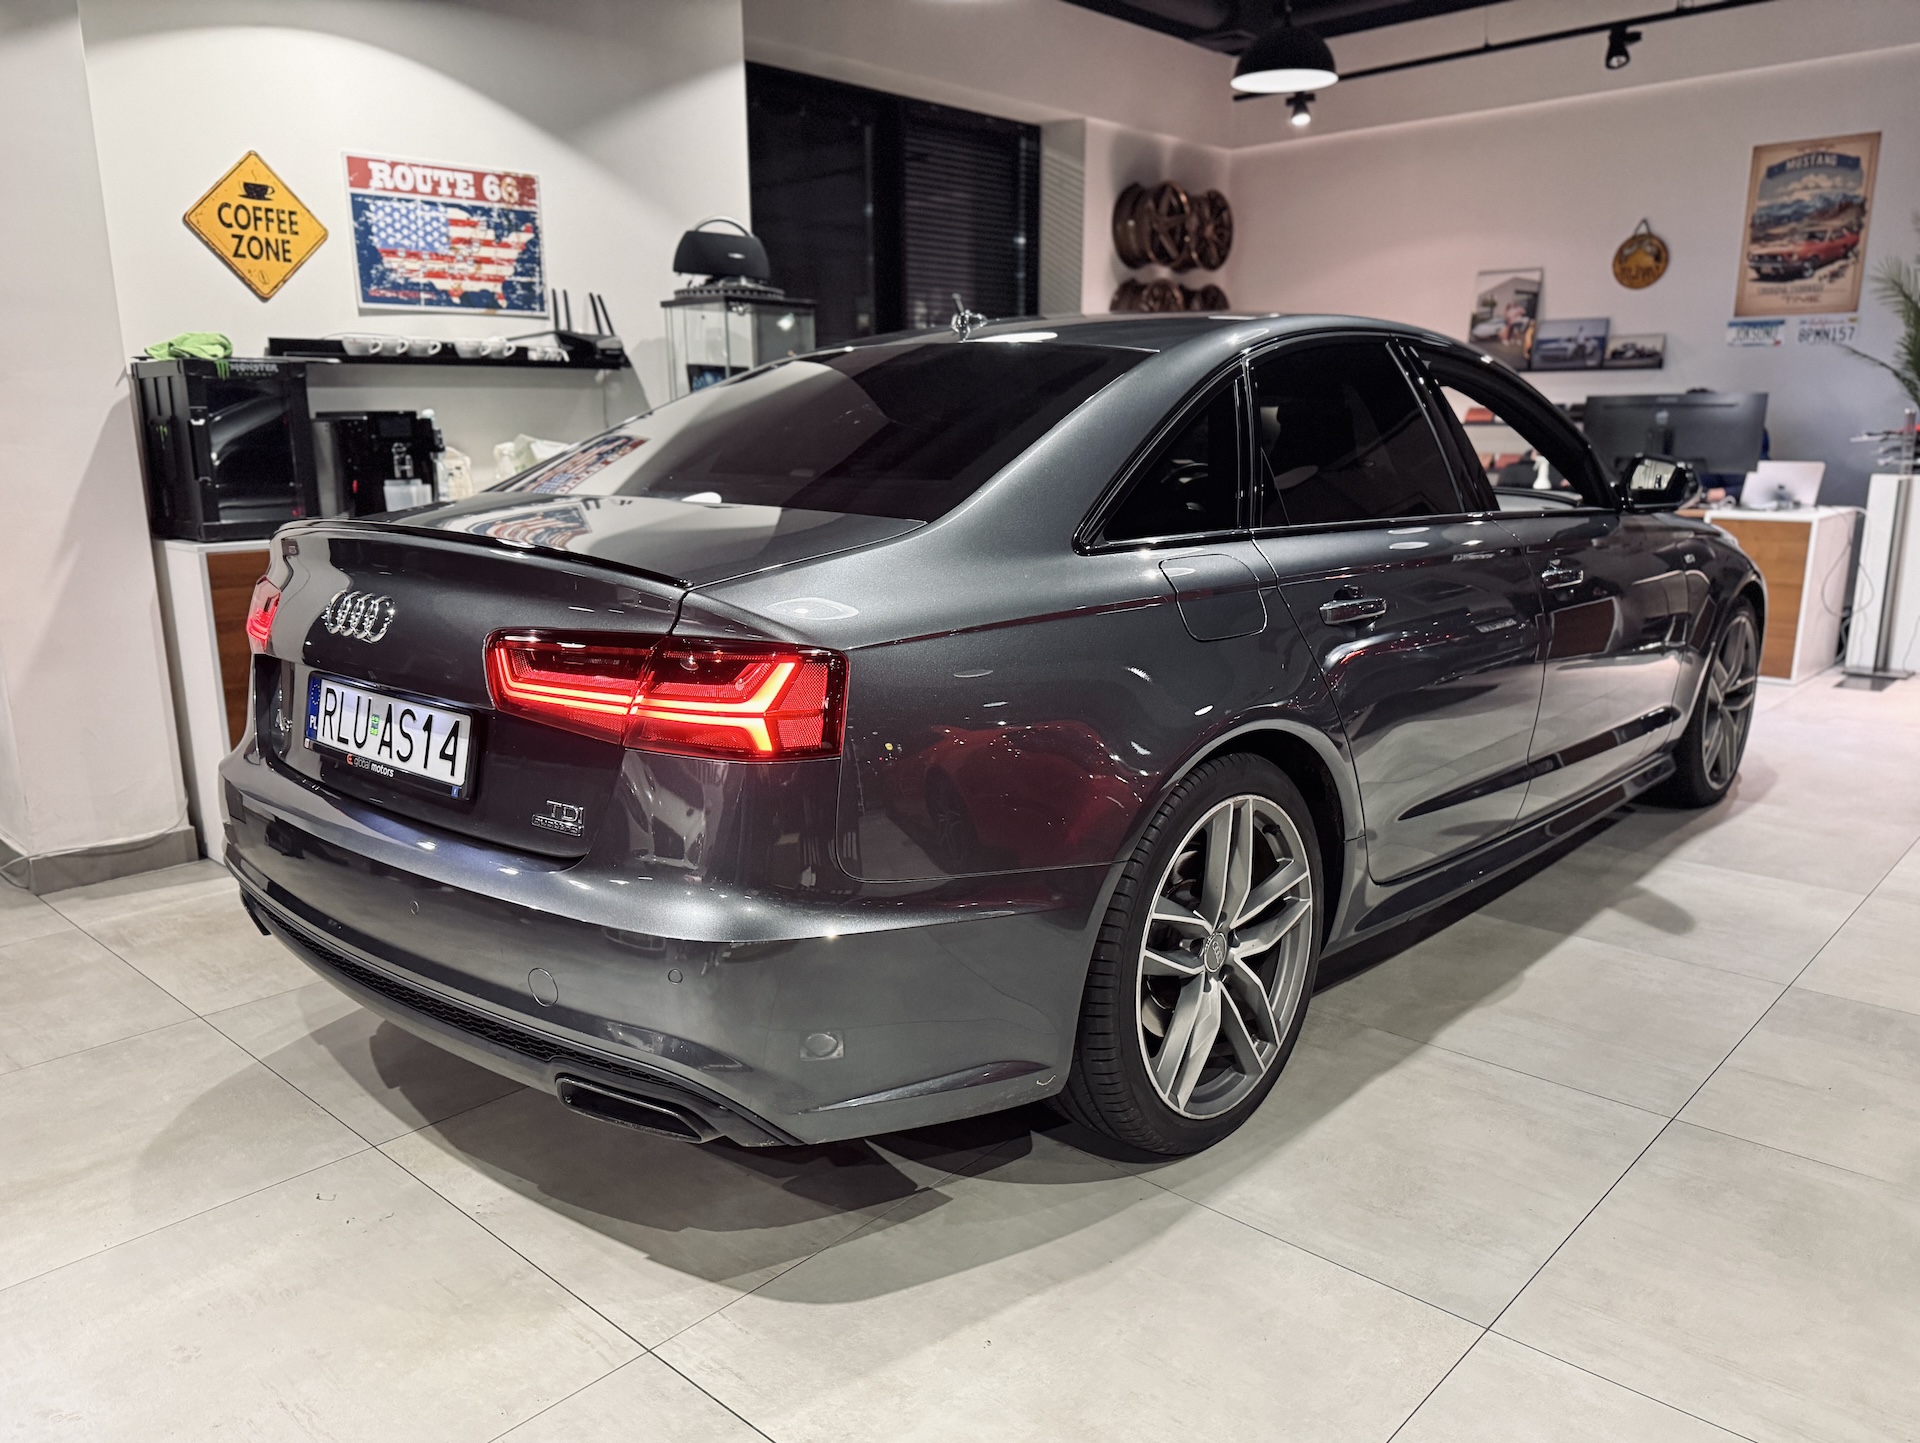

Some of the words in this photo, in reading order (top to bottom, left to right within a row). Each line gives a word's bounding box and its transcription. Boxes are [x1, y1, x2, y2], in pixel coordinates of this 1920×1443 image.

[367, 160, 476, 199] ROUTE
[482, 173, 520, 203] 66
[217, 202, 299, 236] COFFEE
[231, 233, 292, 263] ZONE
[309, 714, 318, 730] PL
[322, 687, 372, 749] RLU
[377, 702, 461, 777] AS14
[370, 763, 395, 778] motors
[546, 800, 584, 824] TDI
